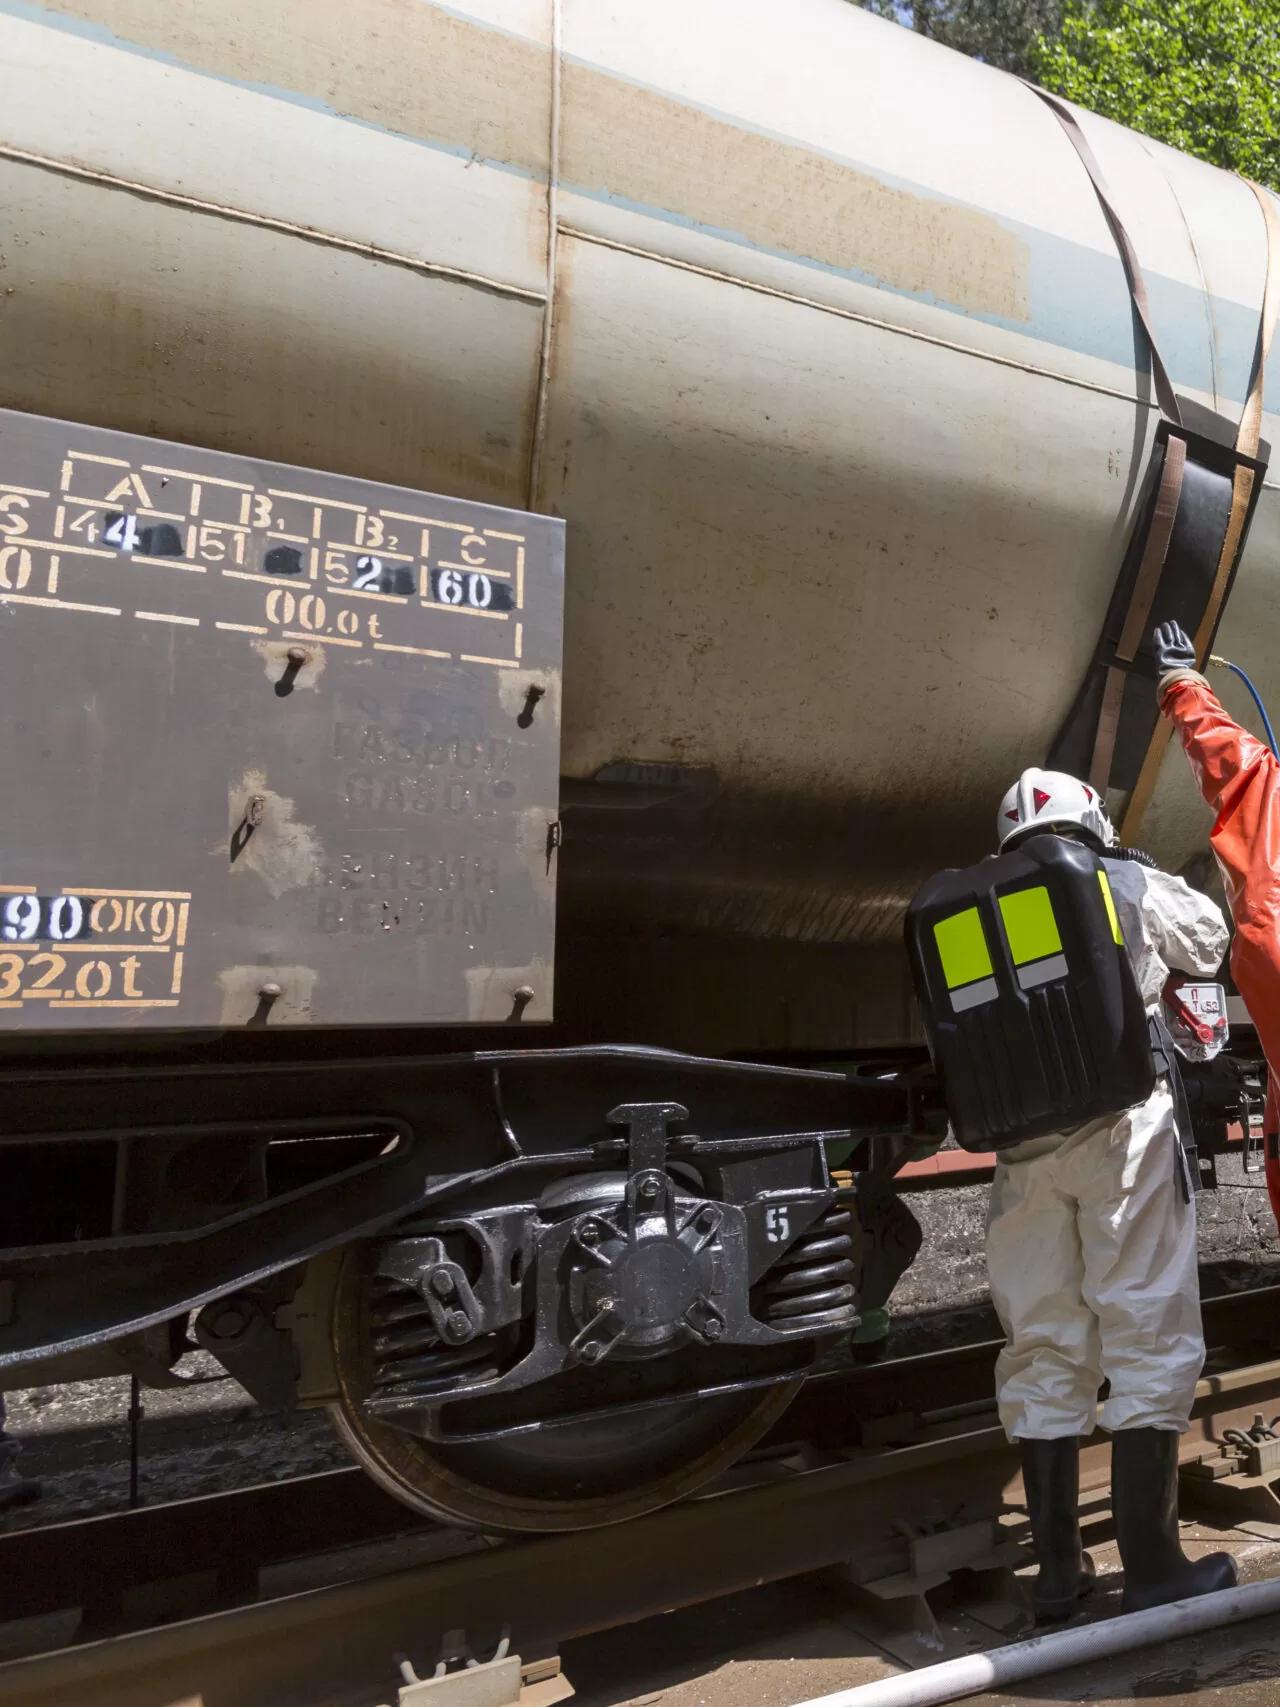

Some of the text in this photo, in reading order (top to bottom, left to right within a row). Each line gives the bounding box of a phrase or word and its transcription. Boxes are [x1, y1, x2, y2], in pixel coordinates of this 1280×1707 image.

[104, 473, 154, 508] A
[461, 534, 487, 565] C
[438, 570, 492, 607] 60
[766, 1206, 790, 1242] 5
